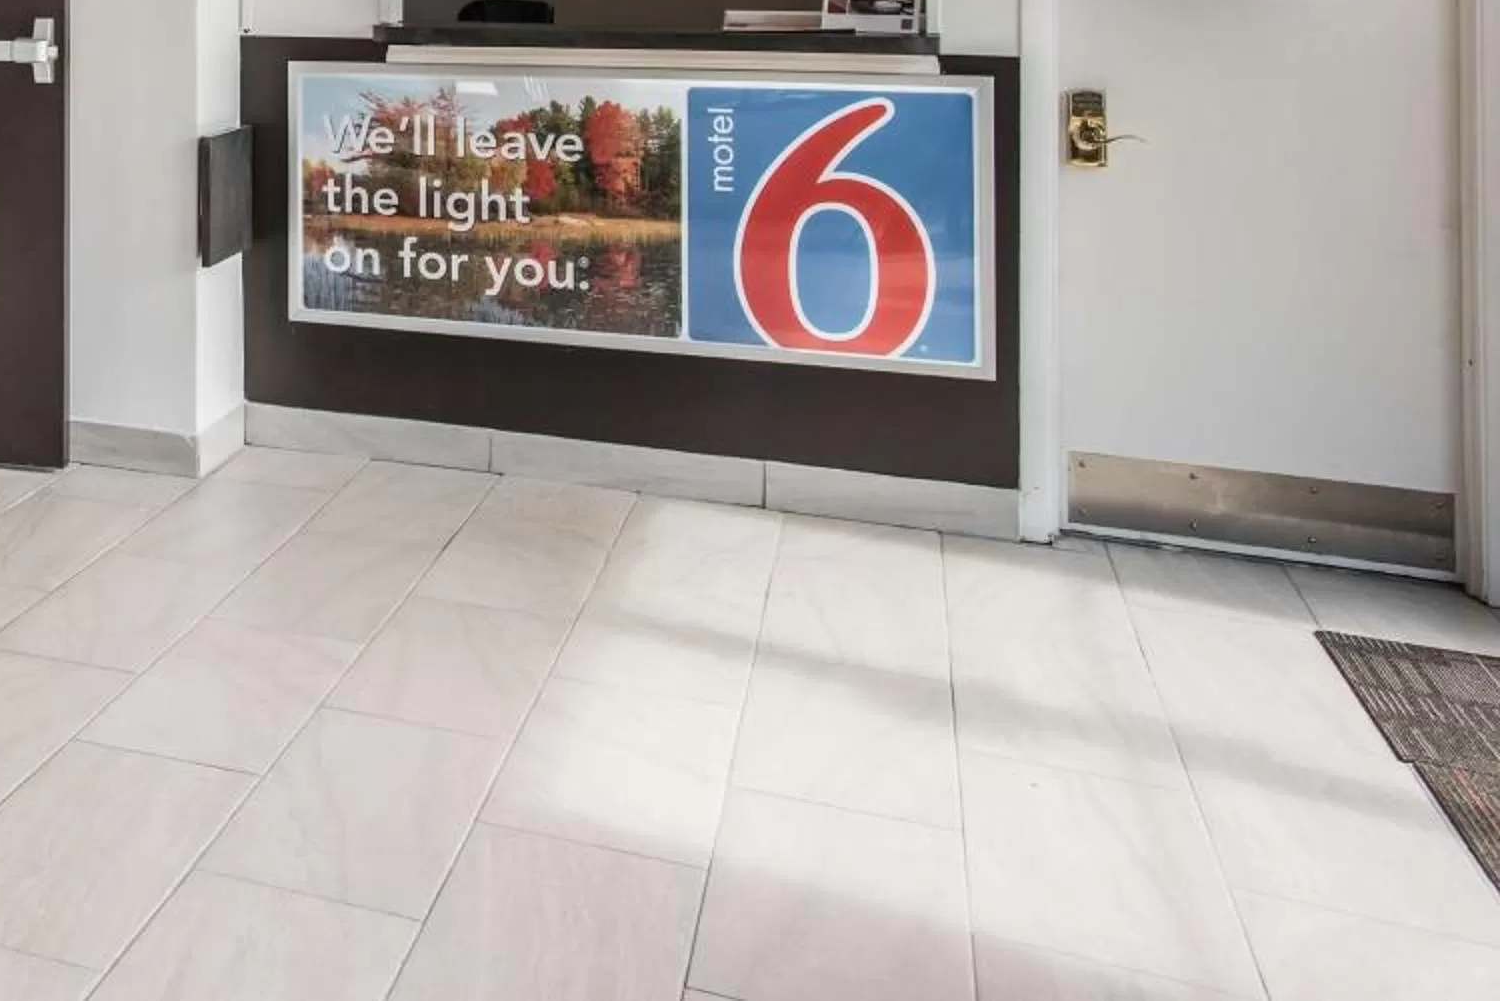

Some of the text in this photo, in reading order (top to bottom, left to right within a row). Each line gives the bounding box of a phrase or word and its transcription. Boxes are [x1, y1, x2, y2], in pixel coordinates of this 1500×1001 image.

[323, 113, 584, 162] We'll leave
[322, 173, 531, 232] the light
[707, 97, 937, 359] motel 6
[324, 244, 381, 276] on
[400, 236, 468, 282] for
